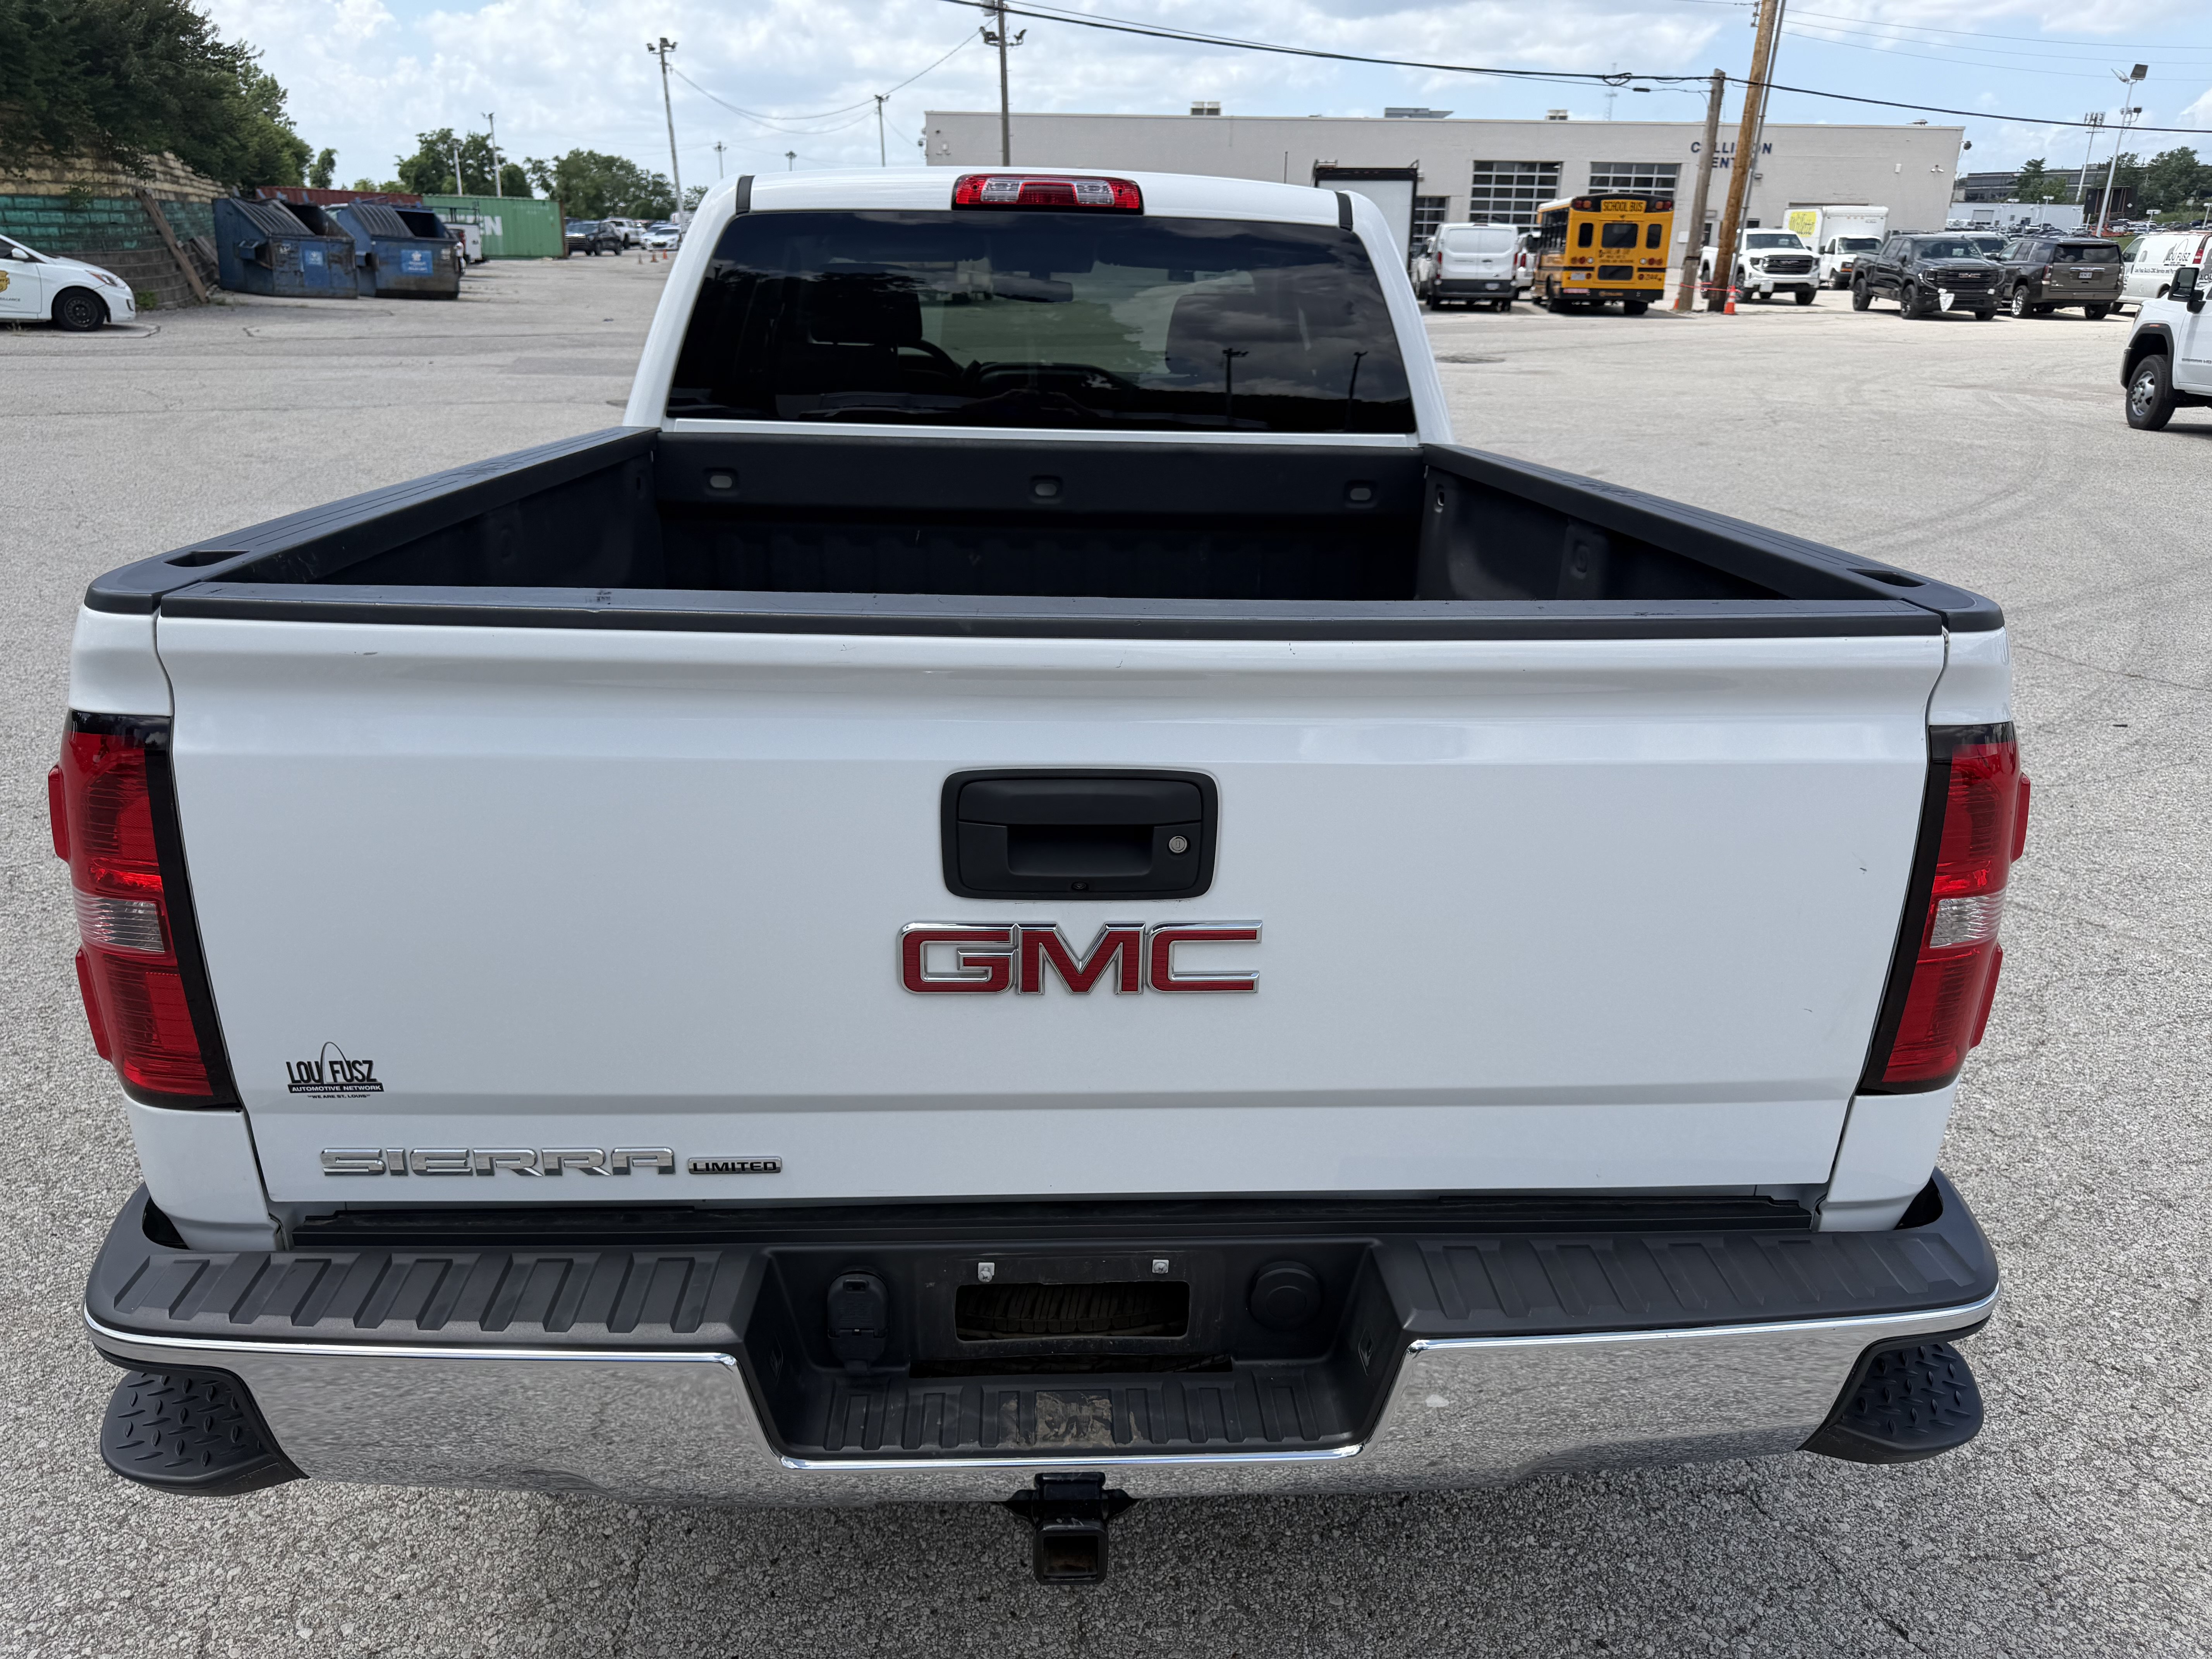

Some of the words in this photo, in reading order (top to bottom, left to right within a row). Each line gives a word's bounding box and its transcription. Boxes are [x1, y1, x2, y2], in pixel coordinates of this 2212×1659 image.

[1603, 201, 1627, 211] SCHOOL
[1629, 201, 1643, 211] BUS
[896, 921, 1263, 995] GMC
[286, 1061, 321, 1084] LOU
[329, 1060, 378, 1083] FUSZ
[320, 1147, 676, 1176] SIERRA
[692, 1162, 777, 1172] LIMITED
